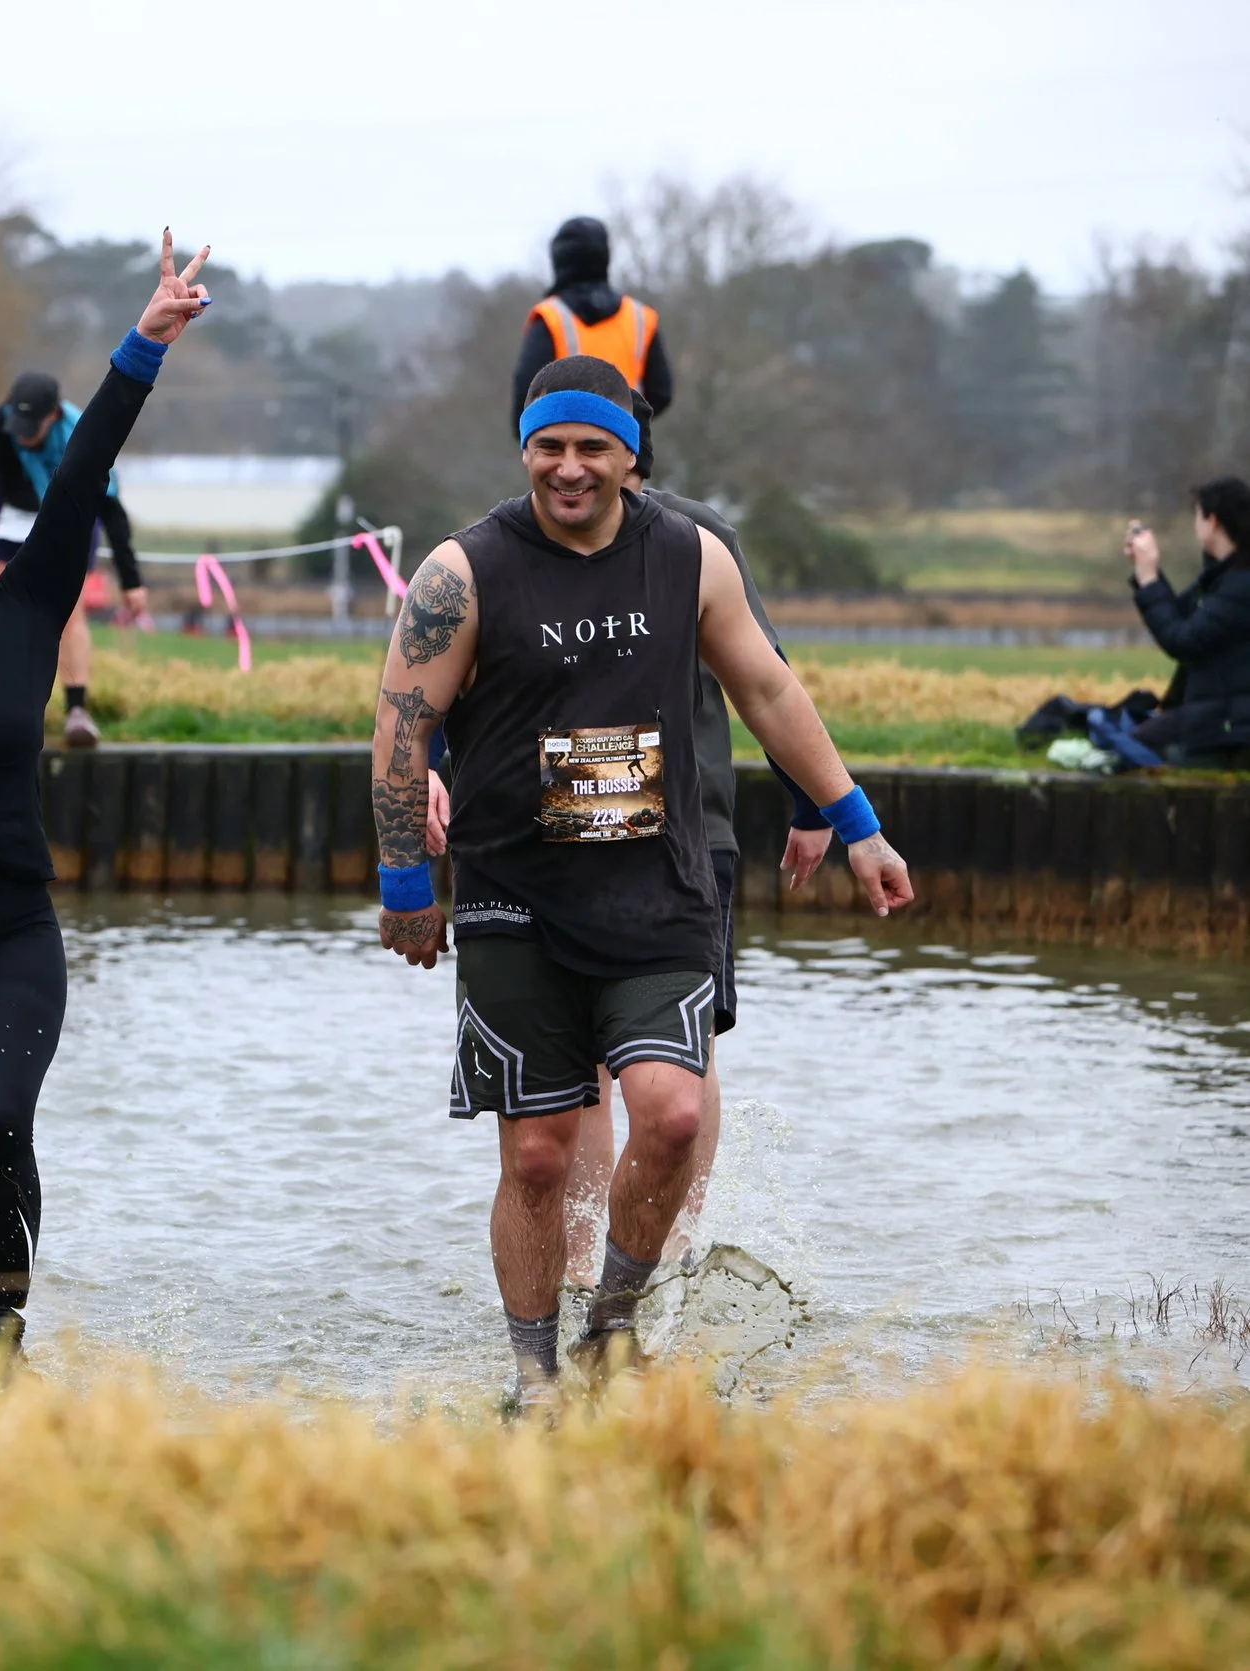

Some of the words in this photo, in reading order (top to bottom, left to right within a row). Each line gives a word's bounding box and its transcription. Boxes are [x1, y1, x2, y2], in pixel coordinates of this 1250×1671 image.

[563, 655, 578, 664] NY
[617, 648, 633, 657] LA
[575, 741, 635, 753] CHALLENGE
[571, 780, 596, 795] THE
[598, 776, 641, 794] BOSSES
[592, 807, 625, 826] 223A
